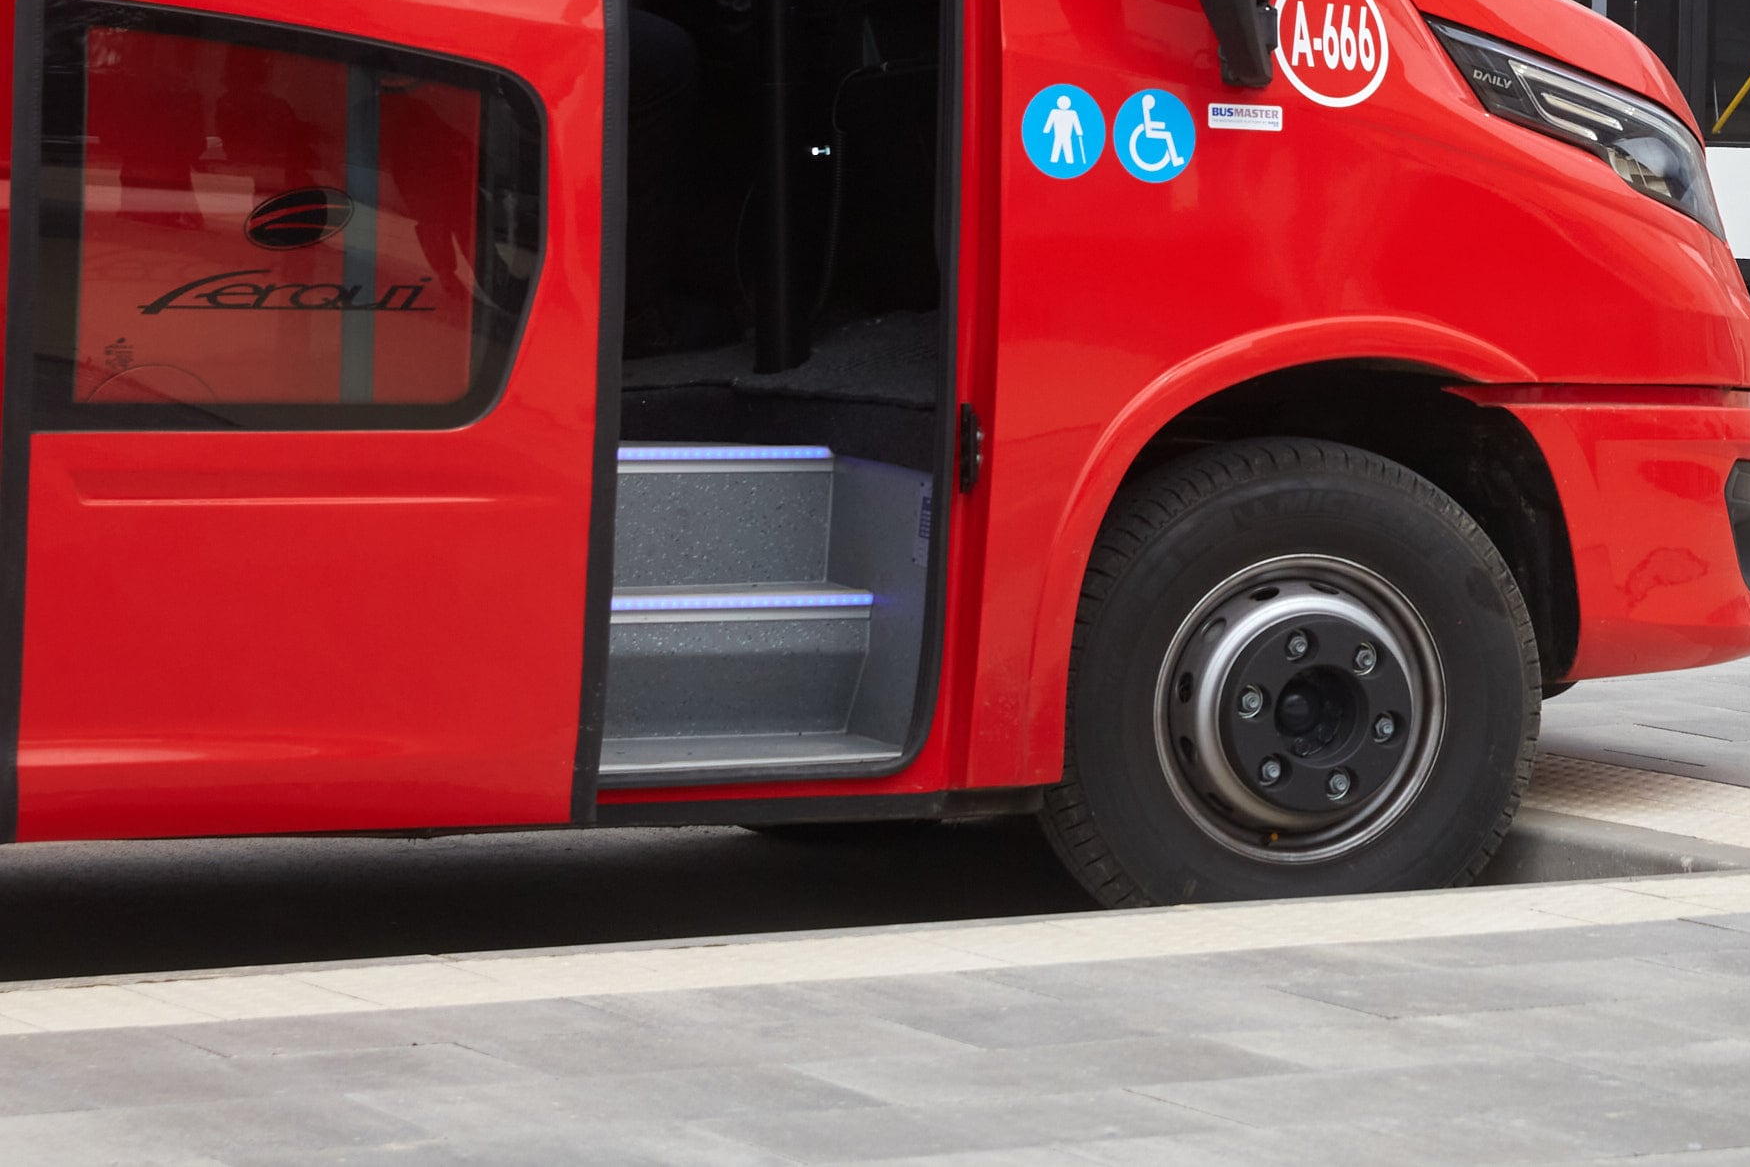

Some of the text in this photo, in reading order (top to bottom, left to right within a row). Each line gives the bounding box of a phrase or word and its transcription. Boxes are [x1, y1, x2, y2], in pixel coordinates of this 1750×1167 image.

[1291, 0, 1376, 73] A-666
[1473, 69, 1512, 89] DAILY
[1211, 107, 1279, 119] BUSMASTER
